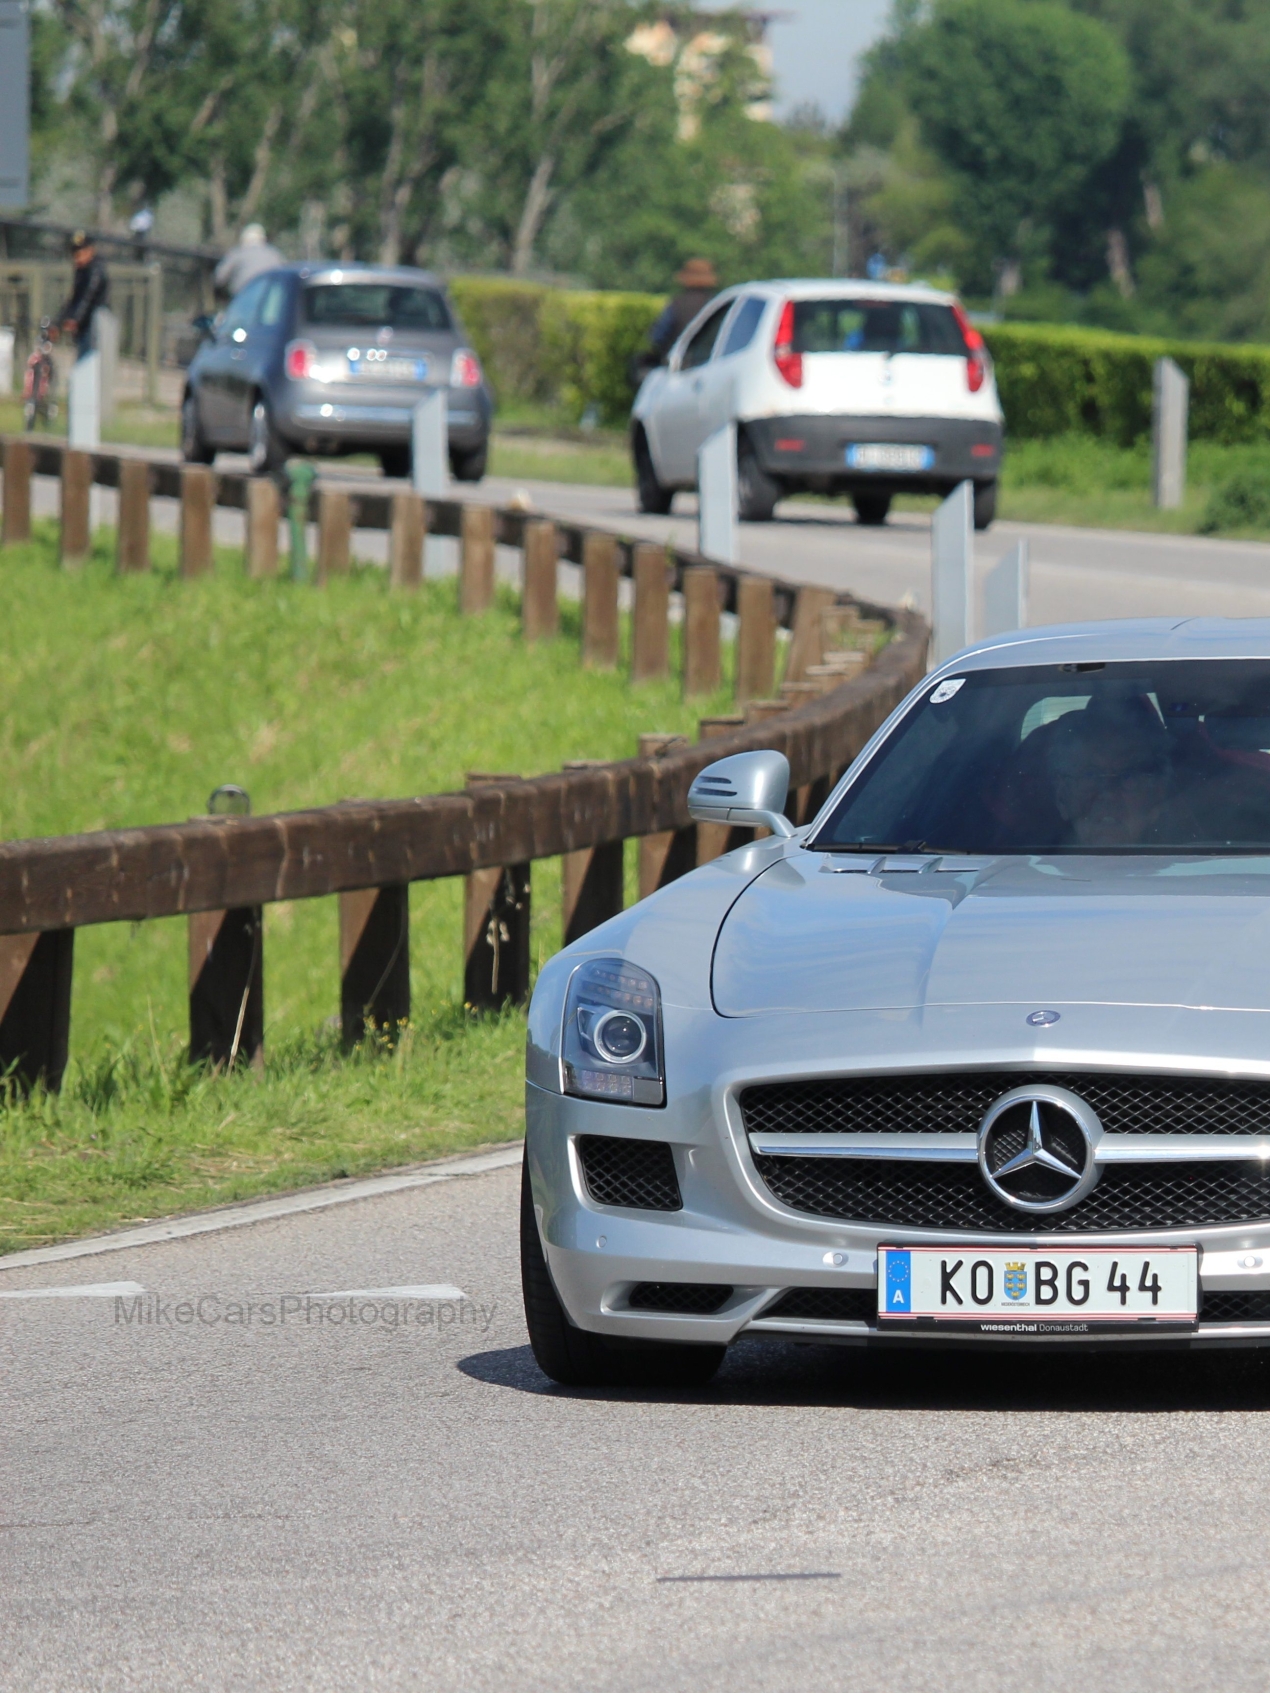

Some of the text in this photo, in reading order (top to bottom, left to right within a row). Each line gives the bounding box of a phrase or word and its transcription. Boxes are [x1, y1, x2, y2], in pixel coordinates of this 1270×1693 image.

[940, 1259, 1162, 1307] KO BG 44
[892, 1289, 905, 1304] A
[980, 1323, 1089, 1333] wiesenthal Donaustadt
